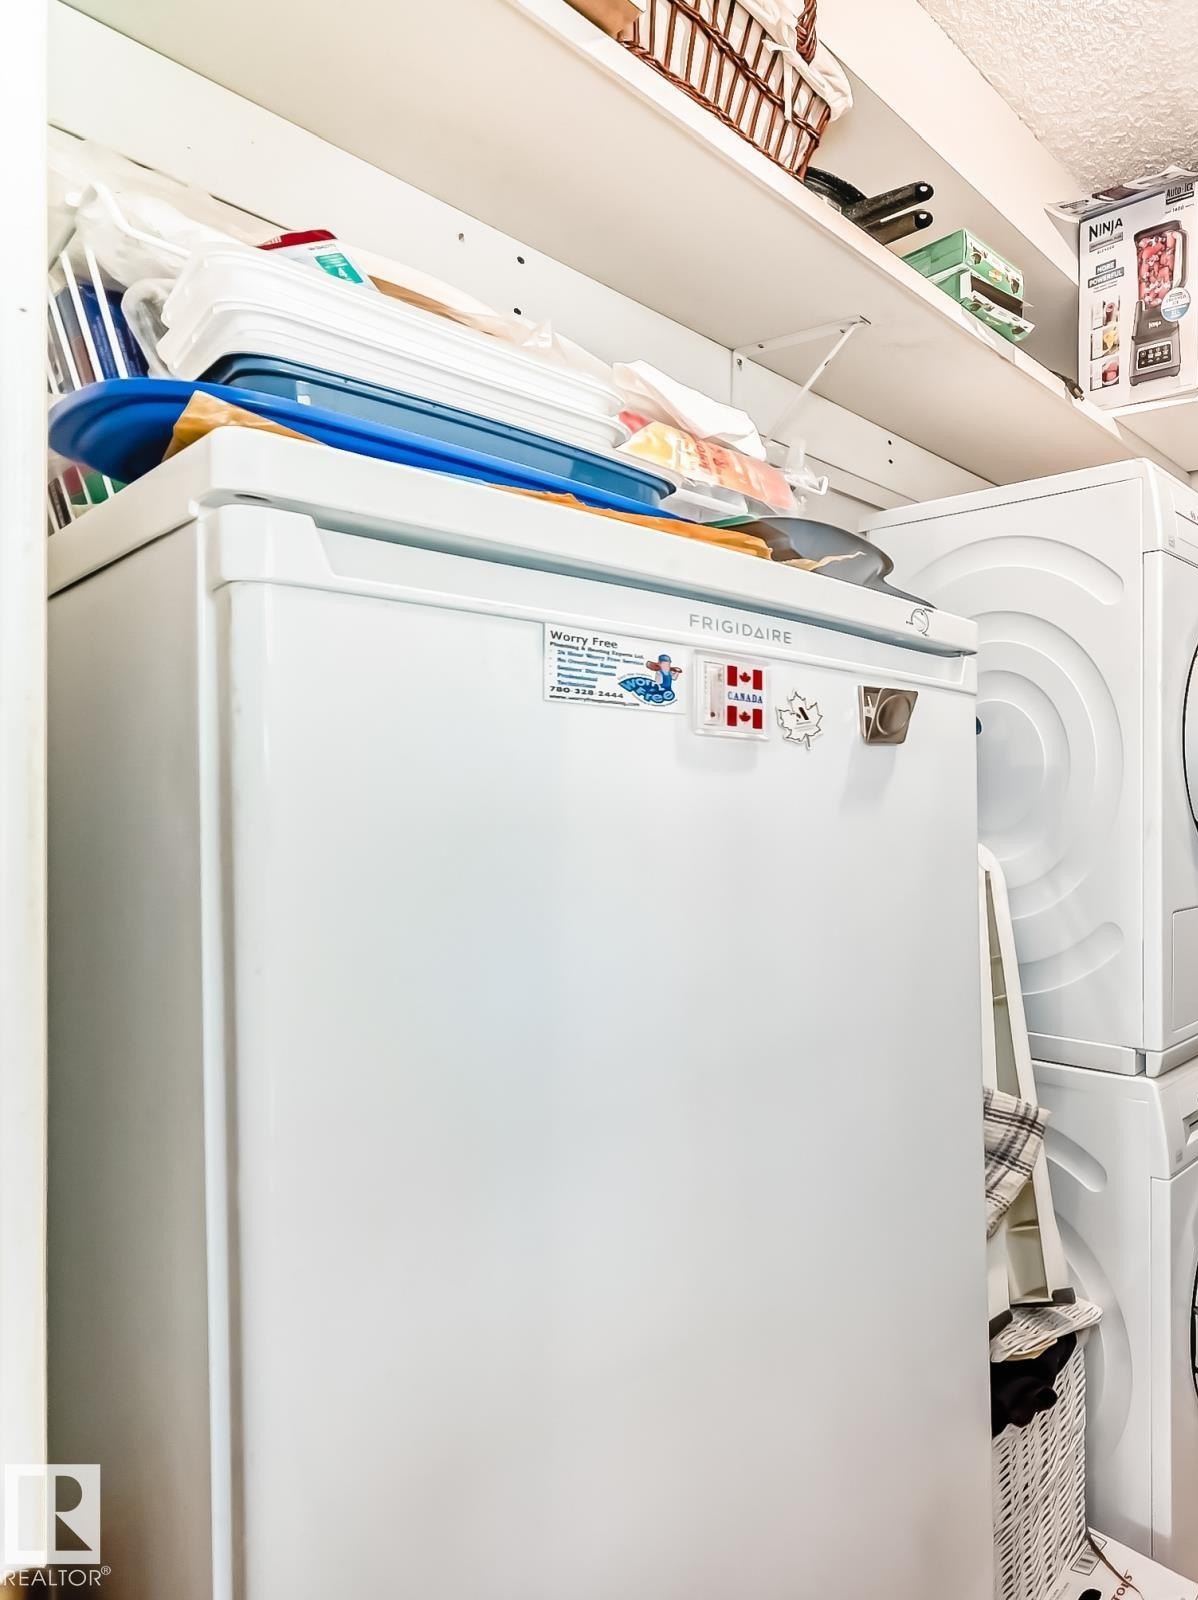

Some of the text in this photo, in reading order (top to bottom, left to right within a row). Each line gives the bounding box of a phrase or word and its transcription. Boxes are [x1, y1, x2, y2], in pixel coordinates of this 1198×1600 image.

[1089, 218, 1123, 242] NINJA
[1097, 261, 1116, 274] MORE
[1088, 267, 1124, 288] POWERFUL
[689, 614, 792, 644] FRIGIDAIRE
[550, 630, 618, 649] Worry Free
[636, 686, 675, 704] Free
[727, 690, 763, 704] CANADA
